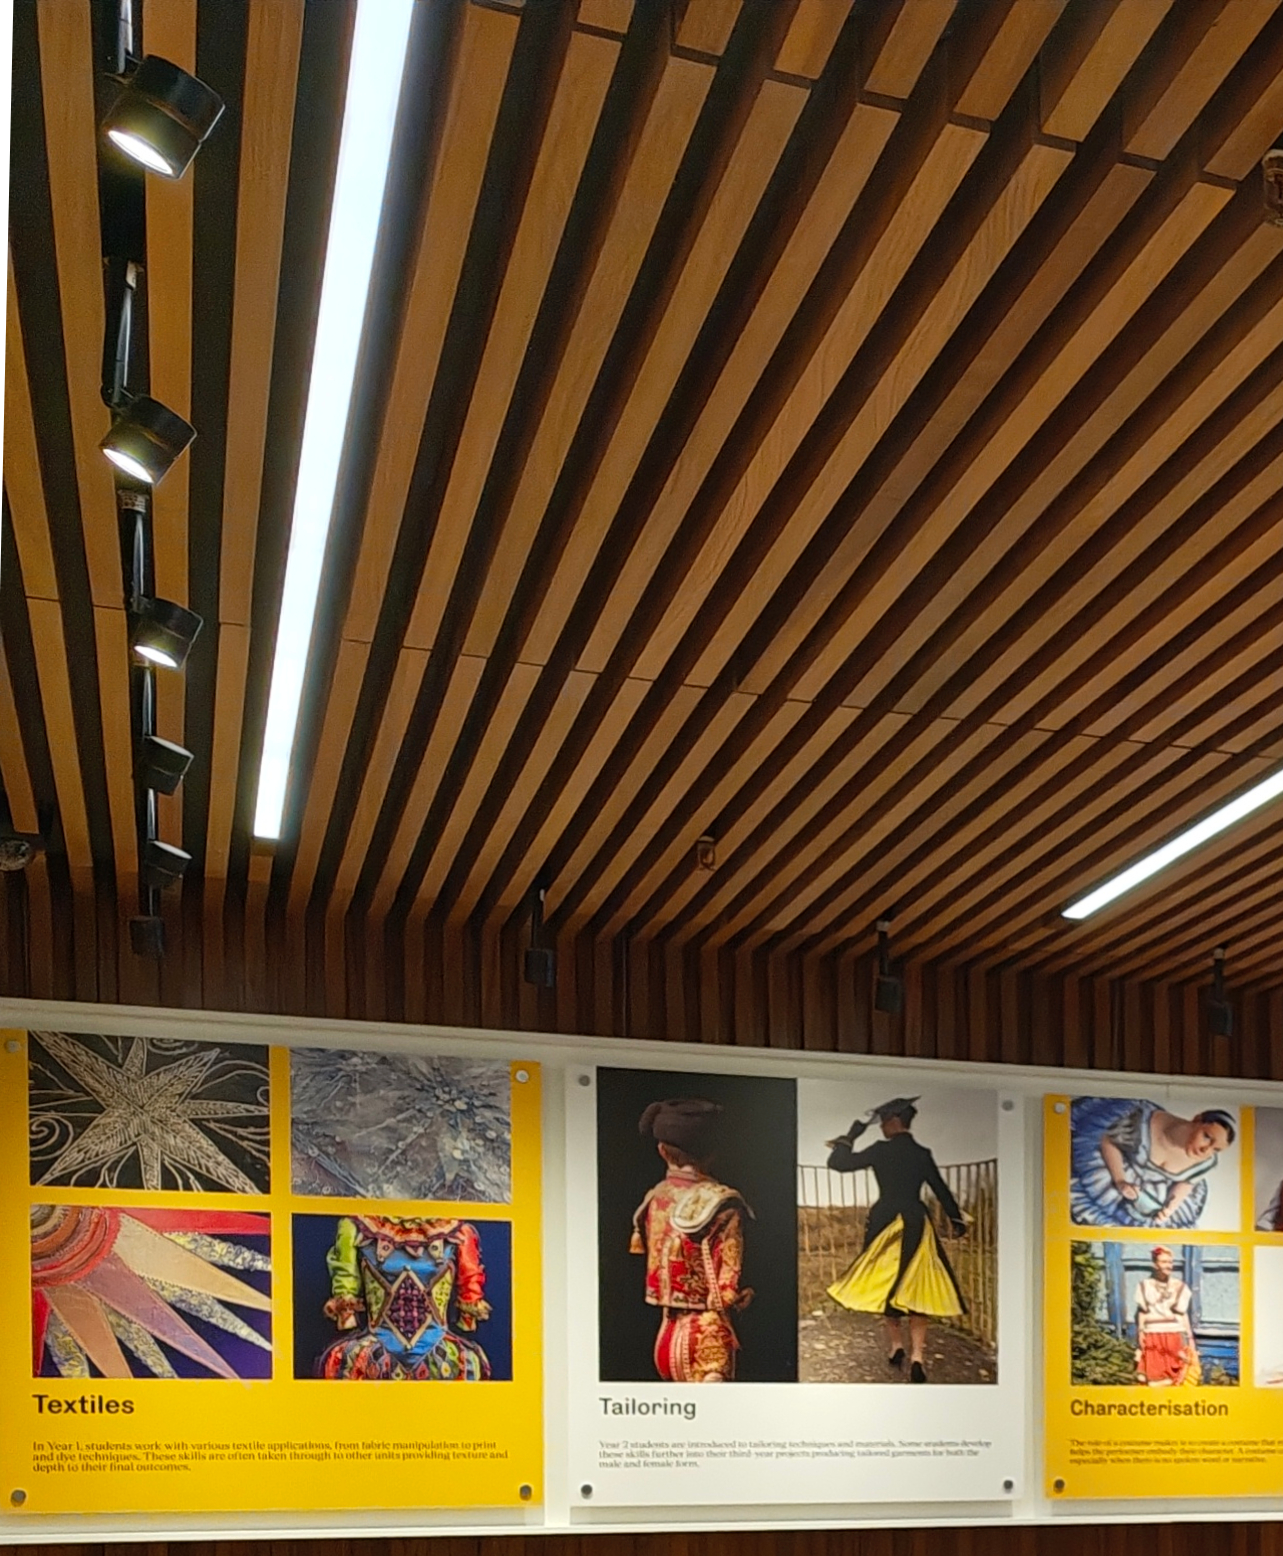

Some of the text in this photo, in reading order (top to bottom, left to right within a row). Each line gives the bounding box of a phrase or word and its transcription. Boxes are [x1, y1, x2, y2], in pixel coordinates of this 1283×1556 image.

[33, 1395, 134, 1415] Textiles
[599, 1397, 696, 1420] Tailoring
[1070, 1399, 1228, 1417] Characterisation
